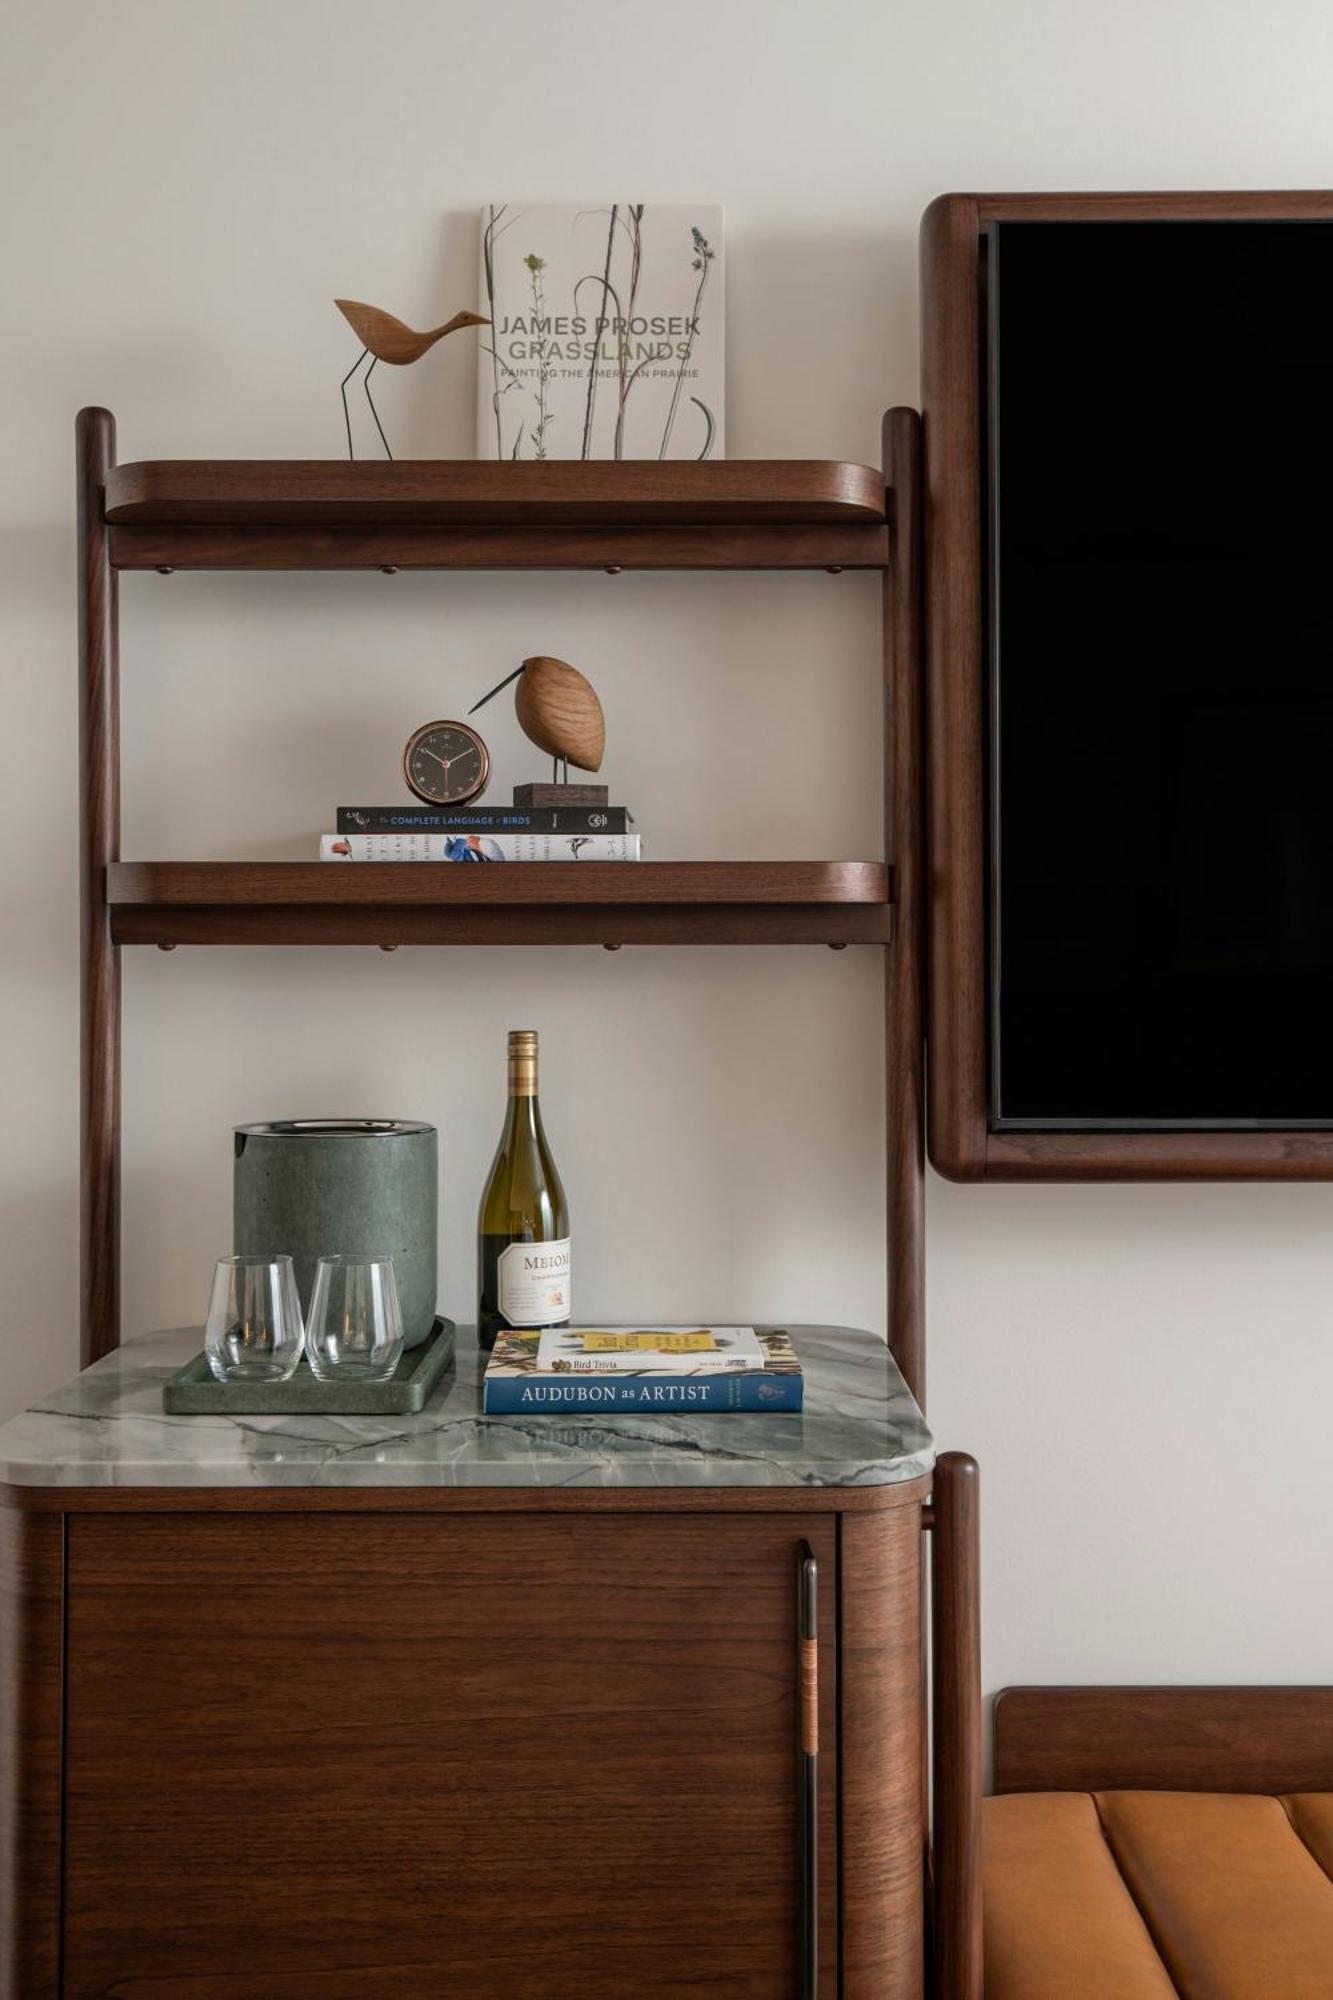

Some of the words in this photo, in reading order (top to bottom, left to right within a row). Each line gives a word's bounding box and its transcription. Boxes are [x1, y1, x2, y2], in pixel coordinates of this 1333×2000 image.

[499, 315, 587, 336] JAMES
[595, 315, 701, 336] PROSEK
[508, 340, 691, 361] GRASSLANDS
[560, 368, 583, 379] THE
[586, 368, 650, 379] AMERCAN
[390, 815, 440, 826] COMPLETE
[442, 815, 495, 826] LANGUAGE
[502, 815, 531, 826] BIRDS
[573, 1359, 592, 1369] Bird
[594, 1360, 617, 1369] Trivia
[522, 1386, 616, 1401] AUDUBON
[621, 1389, 635, 1399] as
[640, 1385, 710, 1400] ARTIST
